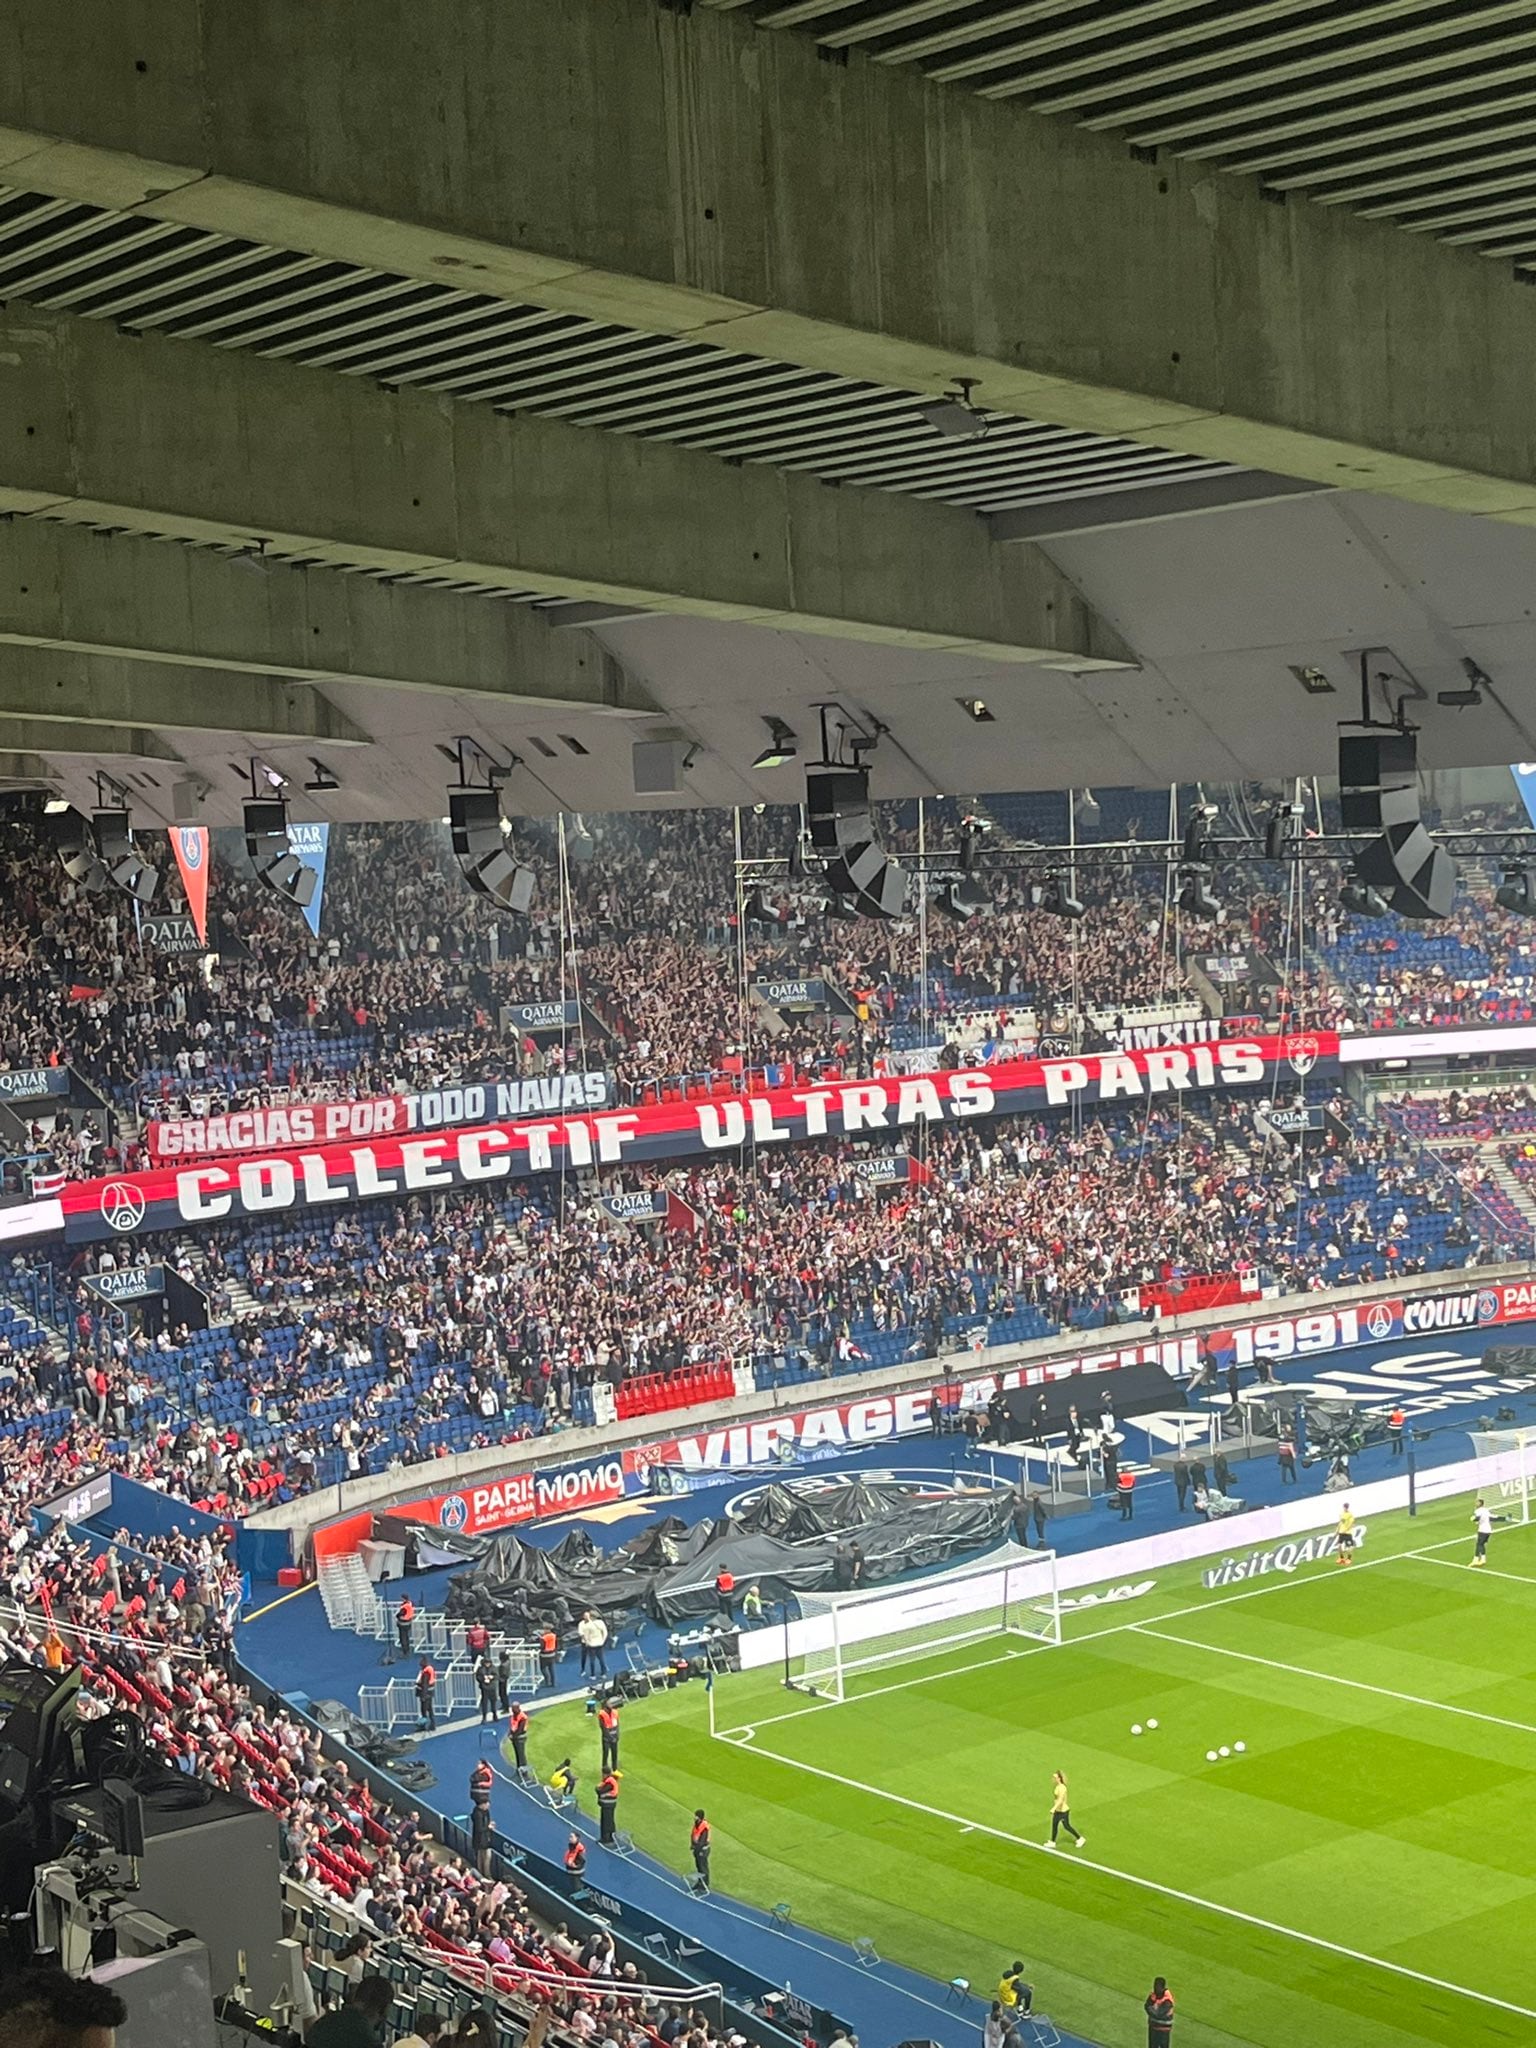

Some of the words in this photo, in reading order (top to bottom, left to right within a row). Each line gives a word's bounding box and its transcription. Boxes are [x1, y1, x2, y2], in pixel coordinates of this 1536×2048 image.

[288, 826, 322, 843] ATAR
[141, 920, 208, 945] QATA
[769, 982, 807, 999] QATAR
[522, 1004, 563, 1022] QATAR
[0, 1071, 47, 1092] QATAR
[158, 1108, 316, 1155] GRACIAS
[326, 1099, 396, 1140] POR
[402, 1086, 485, 1129] TODO
[496, 1072, 606, 1115] NAVAS
[1272, 1110, 1309, 1127] QATAR
[176, 1114, 639, 1221] COLLECTIF
[695, 1072, 996, 1148] ULTRAS
[1040, 1043, 1264, 1105] PARIS
[857, 1159, 896, 1177] QATAR
[611, 1193, 653, 1212] QATAR
[100, 1269, 147, 1292] QATAR
[678, 1389, 934, 1471] VIRAGE
[1233, 1309, 1361, 1365] 1991
[535, 1461, 623, 1506] MOMO
[1500, 1475, 1536, 1497] VIST
